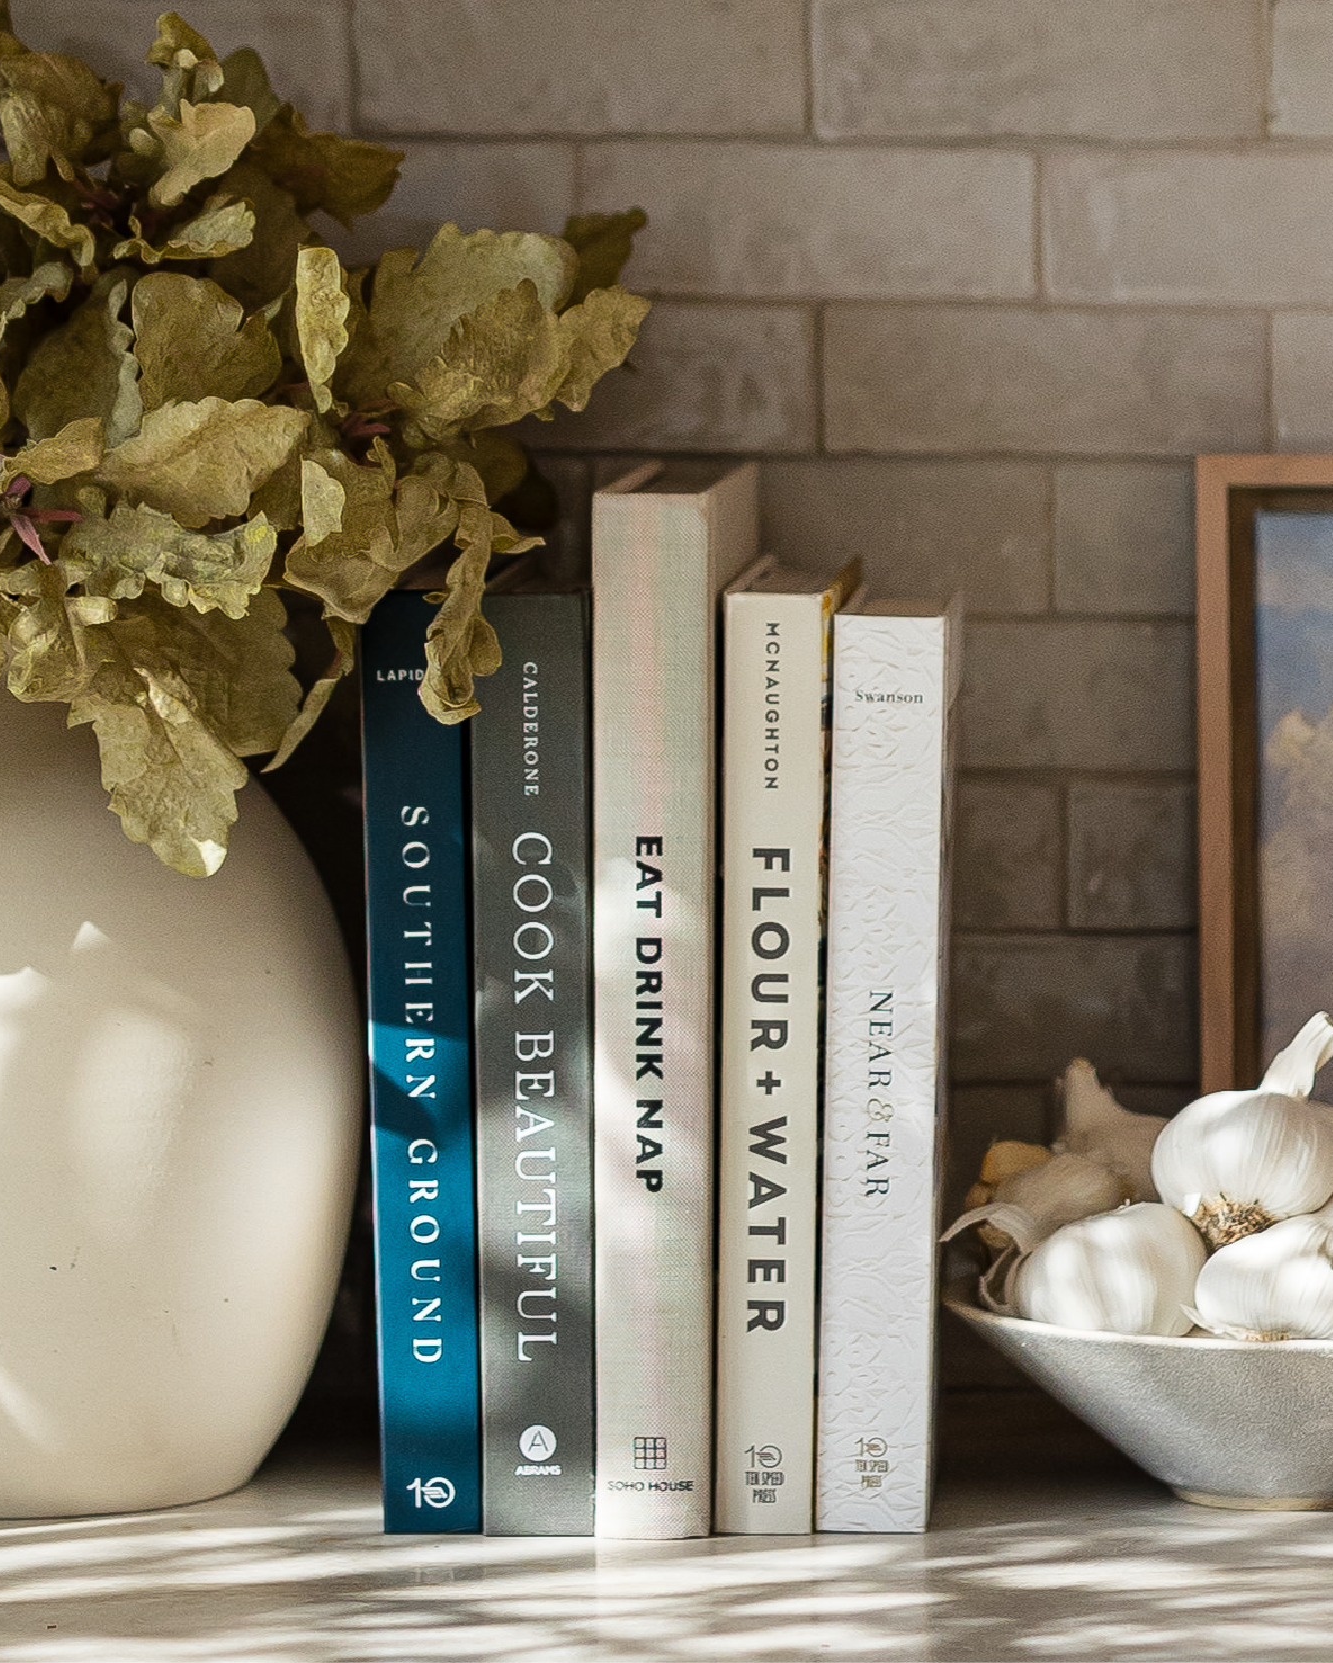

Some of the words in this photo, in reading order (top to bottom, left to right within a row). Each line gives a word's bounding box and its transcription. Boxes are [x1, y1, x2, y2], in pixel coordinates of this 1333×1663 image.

[376, 668, 426, 682] LAPID
[522, 661, 540, 796] CALDERONE
[764, 622, 781, 789] MCNAUGHTON
[854, 689, 924, 704] Swanson
[512, 831, 555, 1005] COOK
[635, 835, 664, 919] EAT
[400, 805, 437, 1100] SOUTHERN
[750, 847, 791, 1052] FLOUR
[635, 936, 664, 1082] DRINK
[867, 990, 894, 1088] NEAR
[756, 1070, 782, 1095] +
[866, 1098, 894, 1122] &
[514, 1029, 558, 1362] BEAUTIFUL
[635, 1098, 664, 1193] NAP
[865, 1131, 890, 1197] FAR
[407, 1138, 443, 1363] GROUND
[746, 1115, 788, 1333] WATER
[607, 1481, 645, 1492] SOHO
[648, 1481, 694, 1492] HOUSE
